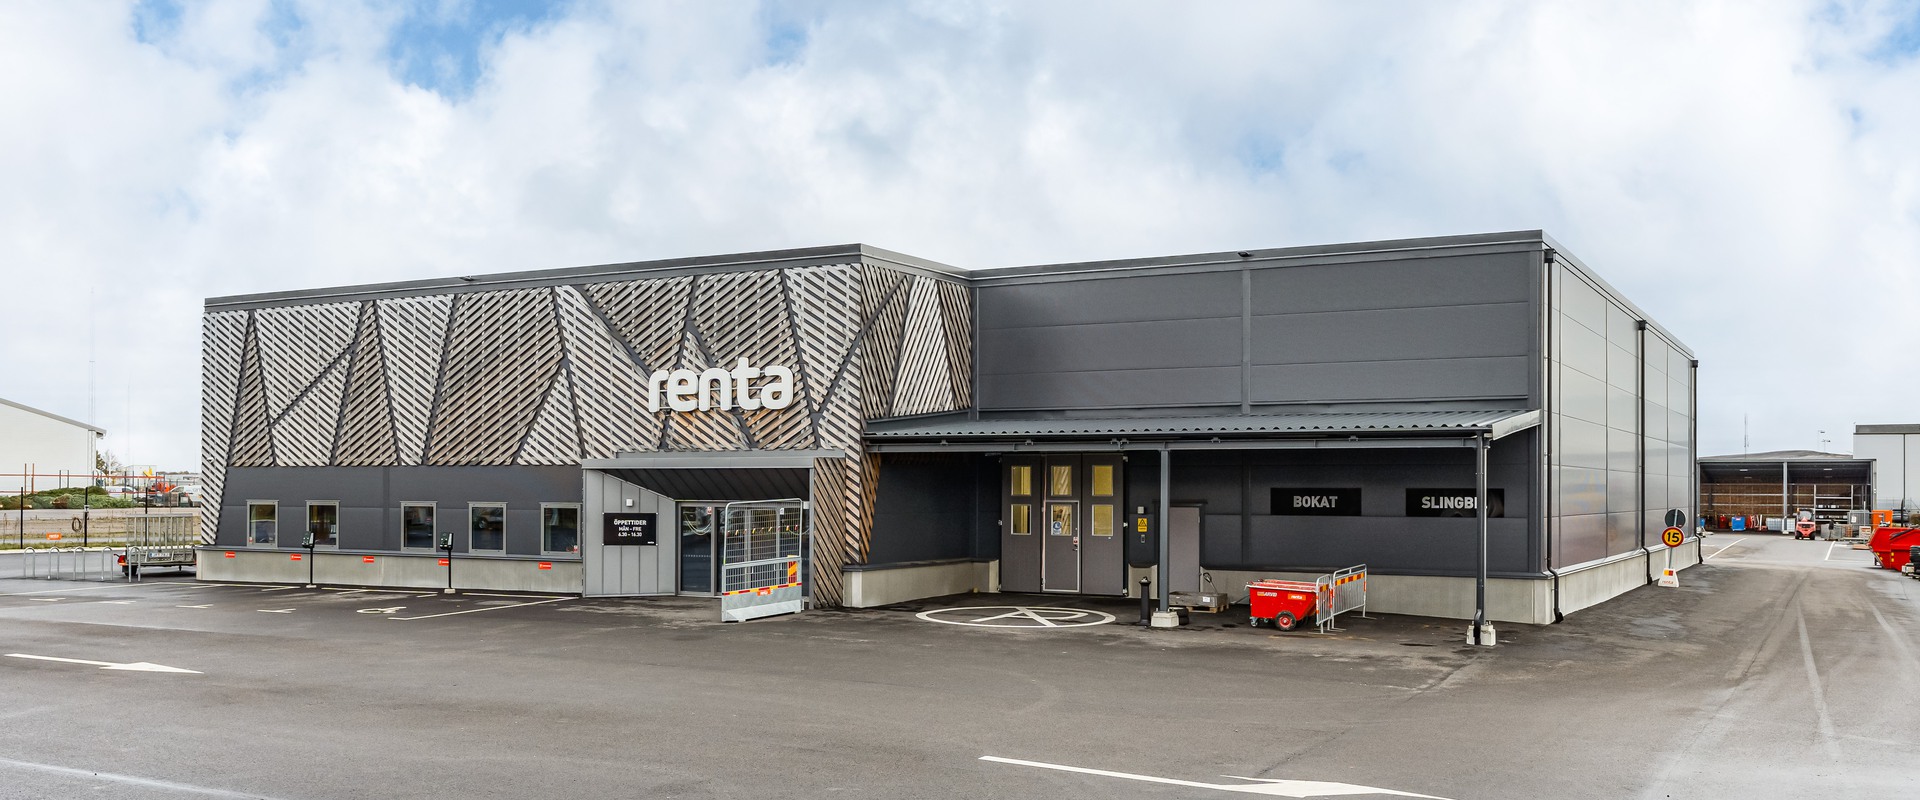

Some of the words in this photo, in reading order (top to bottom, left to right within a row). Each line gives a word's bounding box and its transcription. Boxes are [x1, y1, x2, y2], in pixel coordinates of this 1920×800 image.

[648, 356, 794, 413] renta
[1293, 495, 1338, 508] BOKAT
[1421, 496, 1478, 509] SLINGBI
[613, 518, 647, 526] ÖPPETTIDER
[1667, 531, 1680, 543] 15
